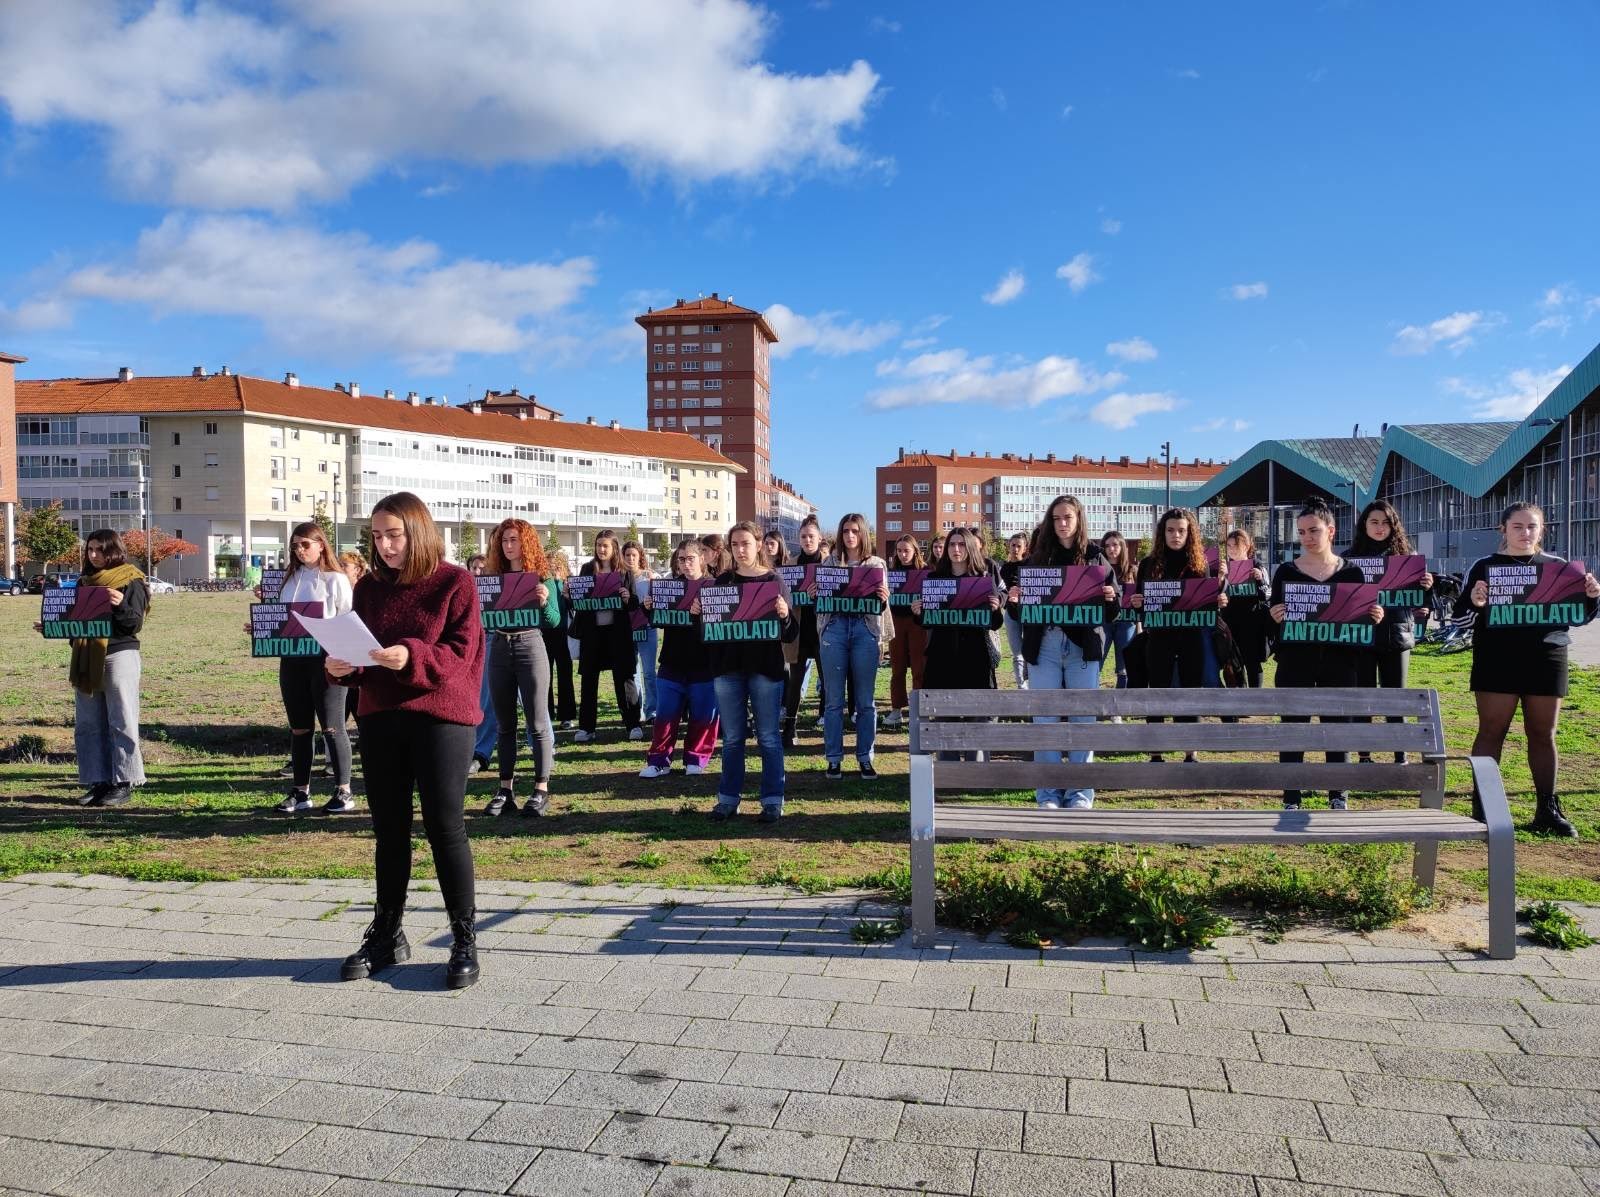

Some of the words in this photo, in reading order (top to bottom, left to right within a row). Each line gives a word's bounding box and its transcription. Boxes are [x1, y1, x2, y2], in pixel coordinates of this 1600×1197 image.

[1020, 568, 1062, 577] INSTITUZIOEN
[1488, 566, 1537, 576] INSTITUZIOEN
[1020, 577, 1062, 586] BERDINTASUN
[1489, 576, 1538, 586] BERDINTASUN
[700, 586, 738, 597] INSTITUZIOEN
[1284, 583, 1331, 594] INSTITUZIOEN
[1489, 586, 1525, 595] FALTSUTIK
[573, 597, 622, 611] ANTOLATU
[701, 595, 740, 605] BERDINTASUN
[1020, 596, 1041, 604] KANPO
[1284, 593, 1331, 604] BERDINTASUN
[1377, 590, 1424, 607] OLATU
[1488, 596, 1513, 605] KANPO
[816, 597, 880, 614] ANTOLATU
[480, 608, 540, 629] NTOLATU
[652, 609, 693, 625] ANTOL
[702, 613, 722, 623] KANPO
[922, 609, 991, 626] ANTOLATU
[1020, 604, 1103, 624] ANTOLATU
[1143, 610, 1217, 628] ANTOLATU
[1283, 612, 1307, 621] KANPO
[1489, 603, 1584, 625] ANTOLATU
[44, 620, 112, 638] ANTOLATU
[703, 620, 779, 641] ANTOLATU
[1283, 621, 1373, 644] ANTOLATU
[254, 636, 321, 656] ANTOLATU
